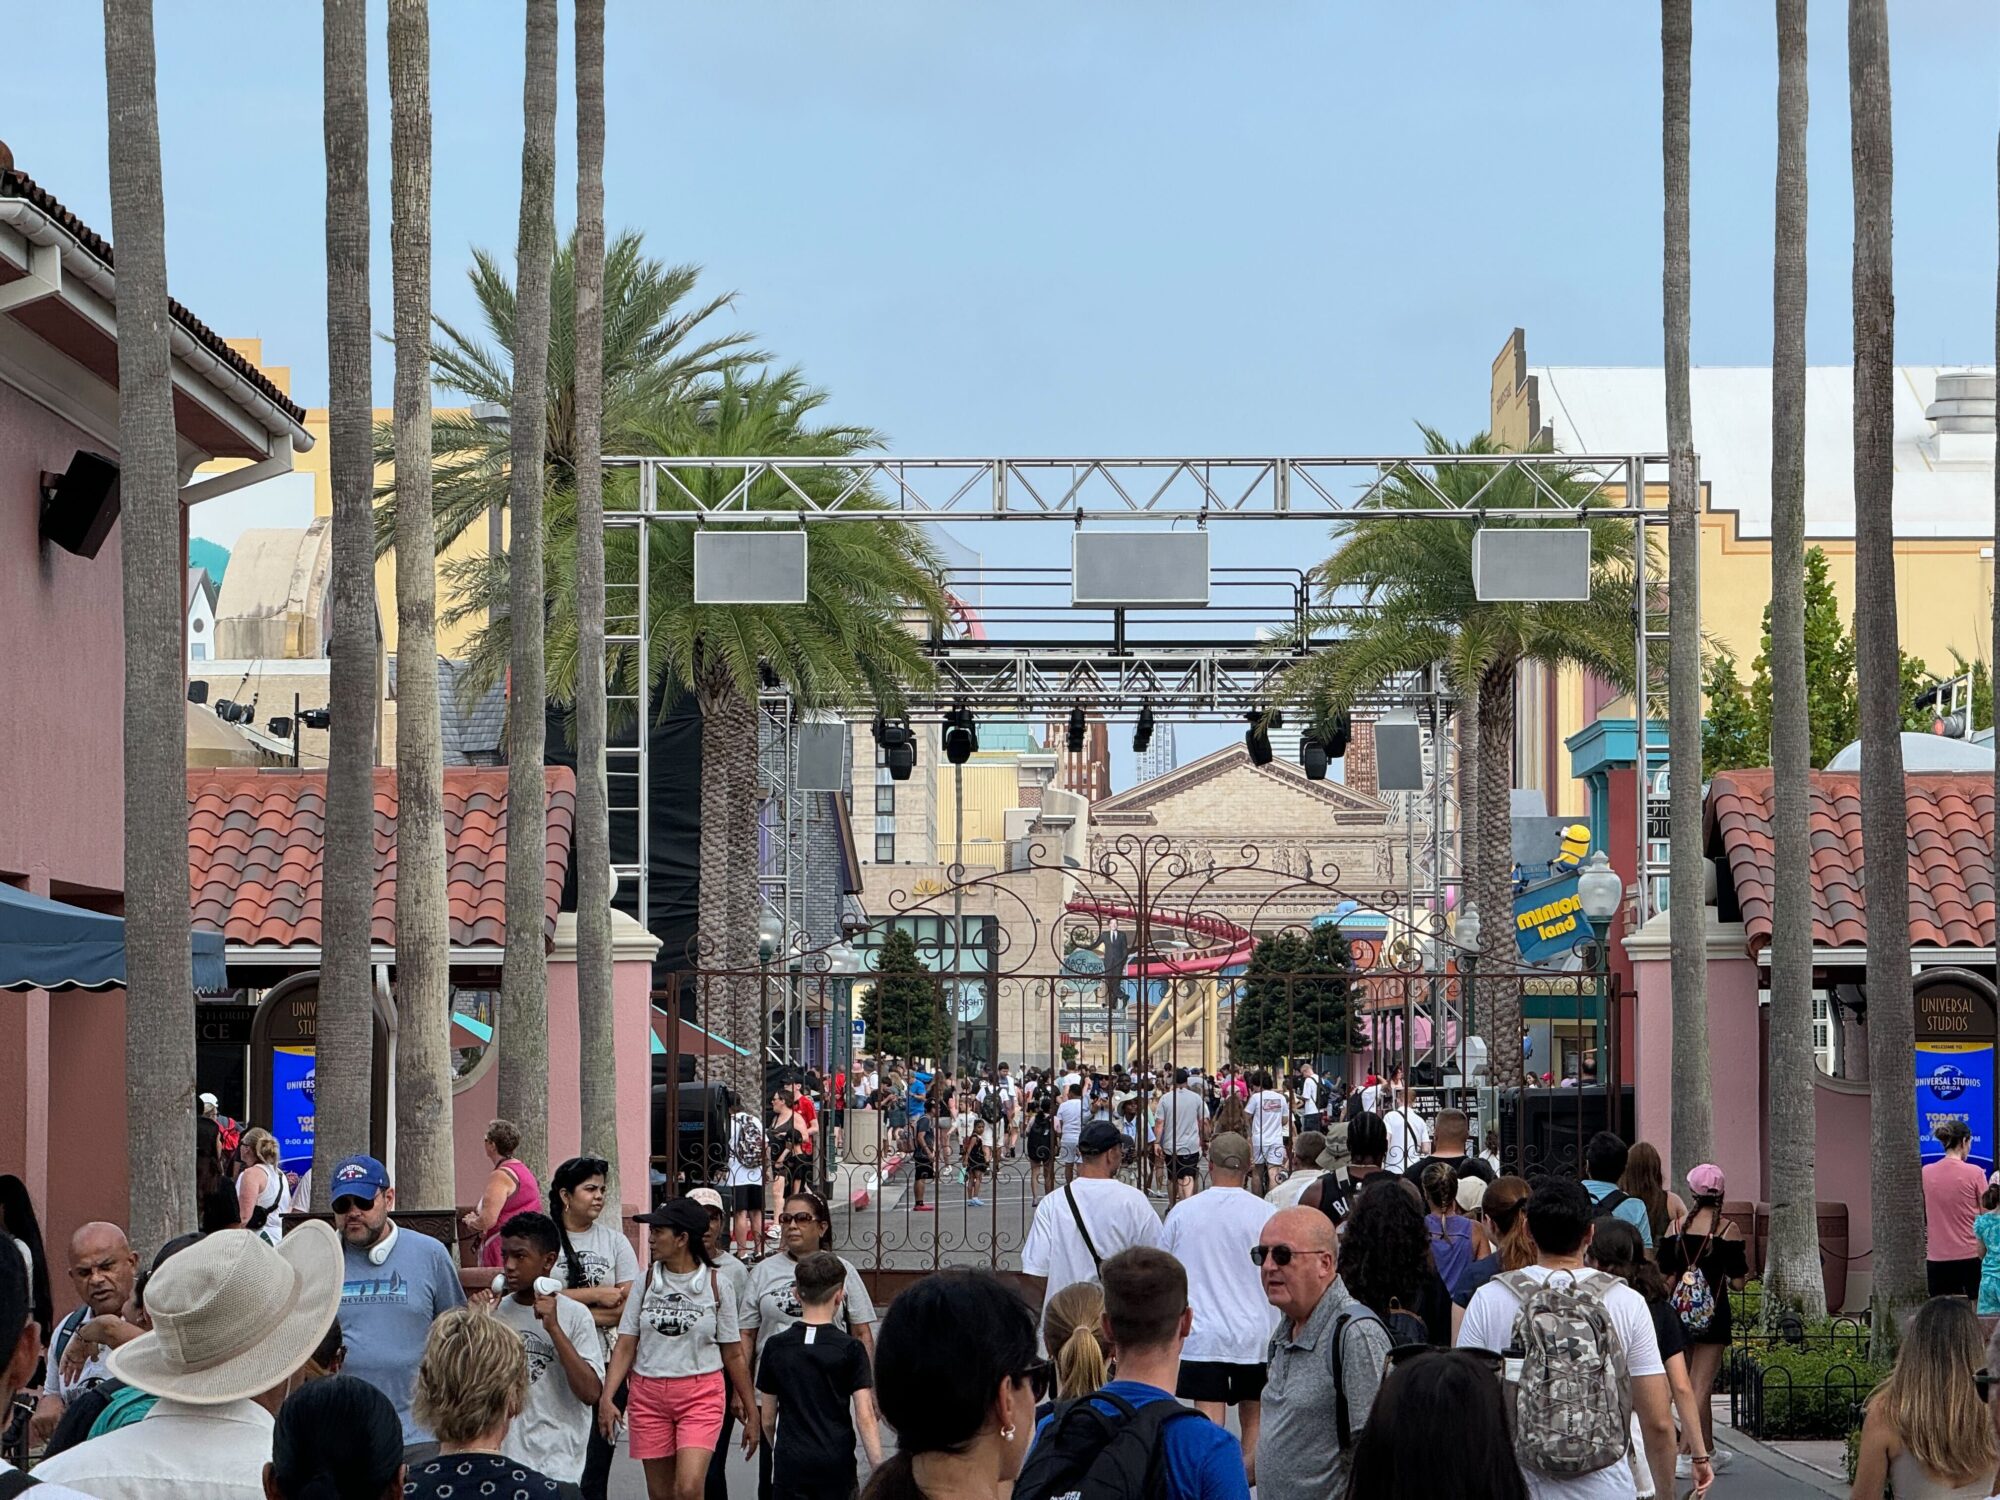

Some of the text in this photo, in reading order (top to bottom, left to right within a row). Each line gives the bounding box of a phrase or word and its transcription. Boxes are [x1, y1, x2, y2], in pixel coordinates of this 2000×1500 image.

[1276, 906, 1318, 914] LIBRARY
[1517, 893, 1583, 930] minion
[1537, 914, 1577, 941] land
[947, 998, 983, 1006] TNGHT
[1921, 998, 1974, 1013] UNIVERSAL
[1071, 1022, 1103, 1032] NBC
[1927, 1015, 1968, 1031] STUDIOS
[1952, 1077, 1981, 1088] STUDIOS
[1925, 1112, 1969, 1122] TODAY'S
